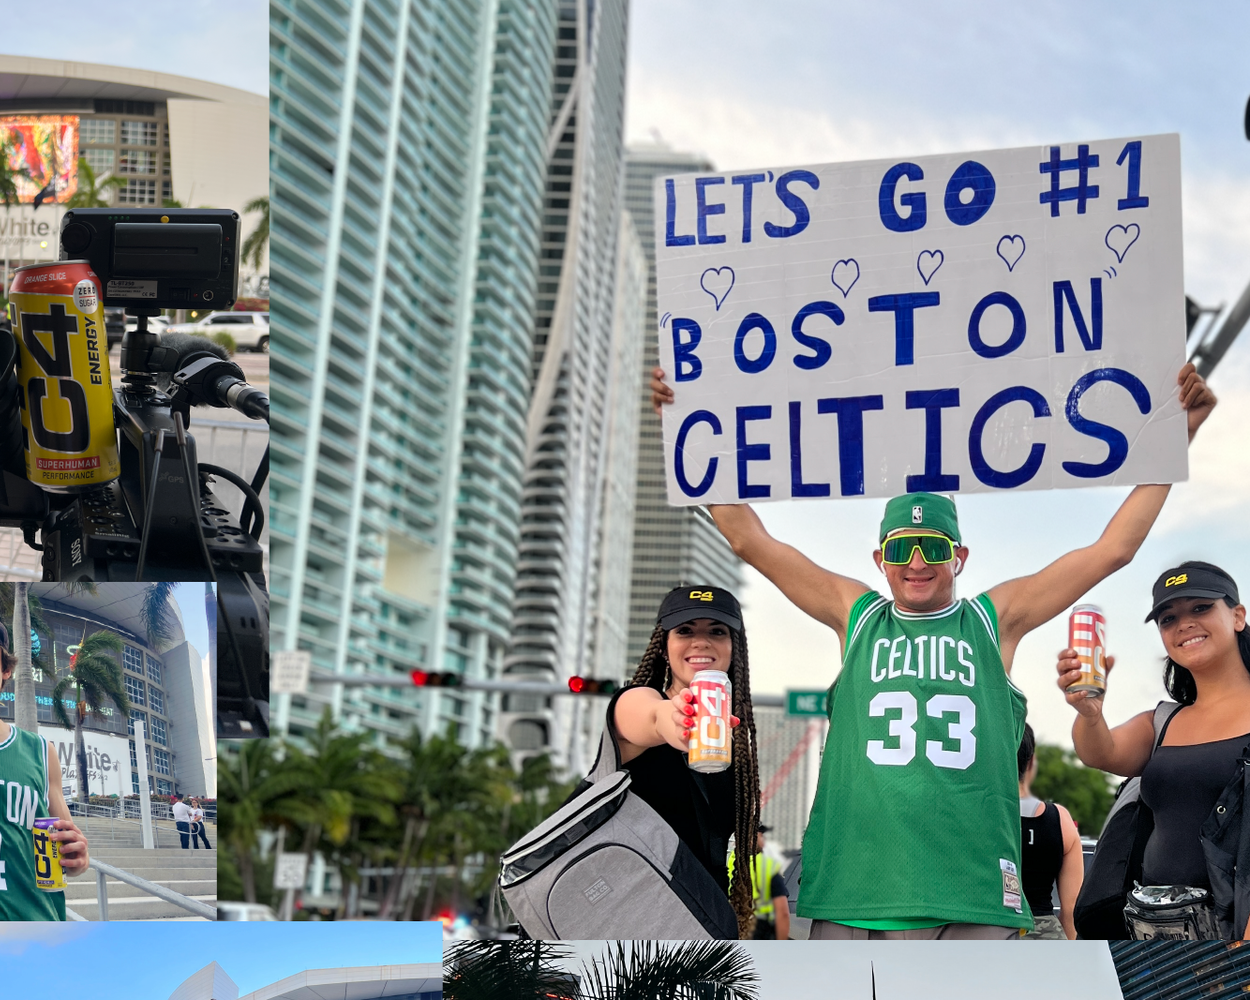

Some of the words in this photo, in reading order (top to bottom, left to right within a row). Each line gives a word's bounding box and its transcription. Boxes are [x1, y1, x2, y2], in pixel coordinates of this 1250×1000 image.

[664, 168, 820, 247] LET'S
[878, 160, 996, 233] GO
[1039, 140, 1150, 218] #1
[24, 273, 48, 285] ORANGE
[48, 271, 67, 282] SLICE
[77, 286, 96, 295] ZERO
[79, 298, 97, 308] SUGAR
[84, 316, 103, 386] ENERGY
[20, 302, 92, 455] C4
[674, 367, 1152, 500] CELTICS
[38, 457, 98, 470] SUPERHUMAN
[42, 470, 95, 481] PERFORMANCE
[167, 474, 185, 484] GPS
[71, 537, 83, 568] SONY
[689, 590, 714, 602] C4
[1164, 573, 1189, 588] C4
[871, 633, 977, 688] CELTICS
[700, 686, 727, 749] C4
[866, 690, 978, 771] 33
[51, 740, 112, 773] Wite
[34, 831, 52, 879] C4
